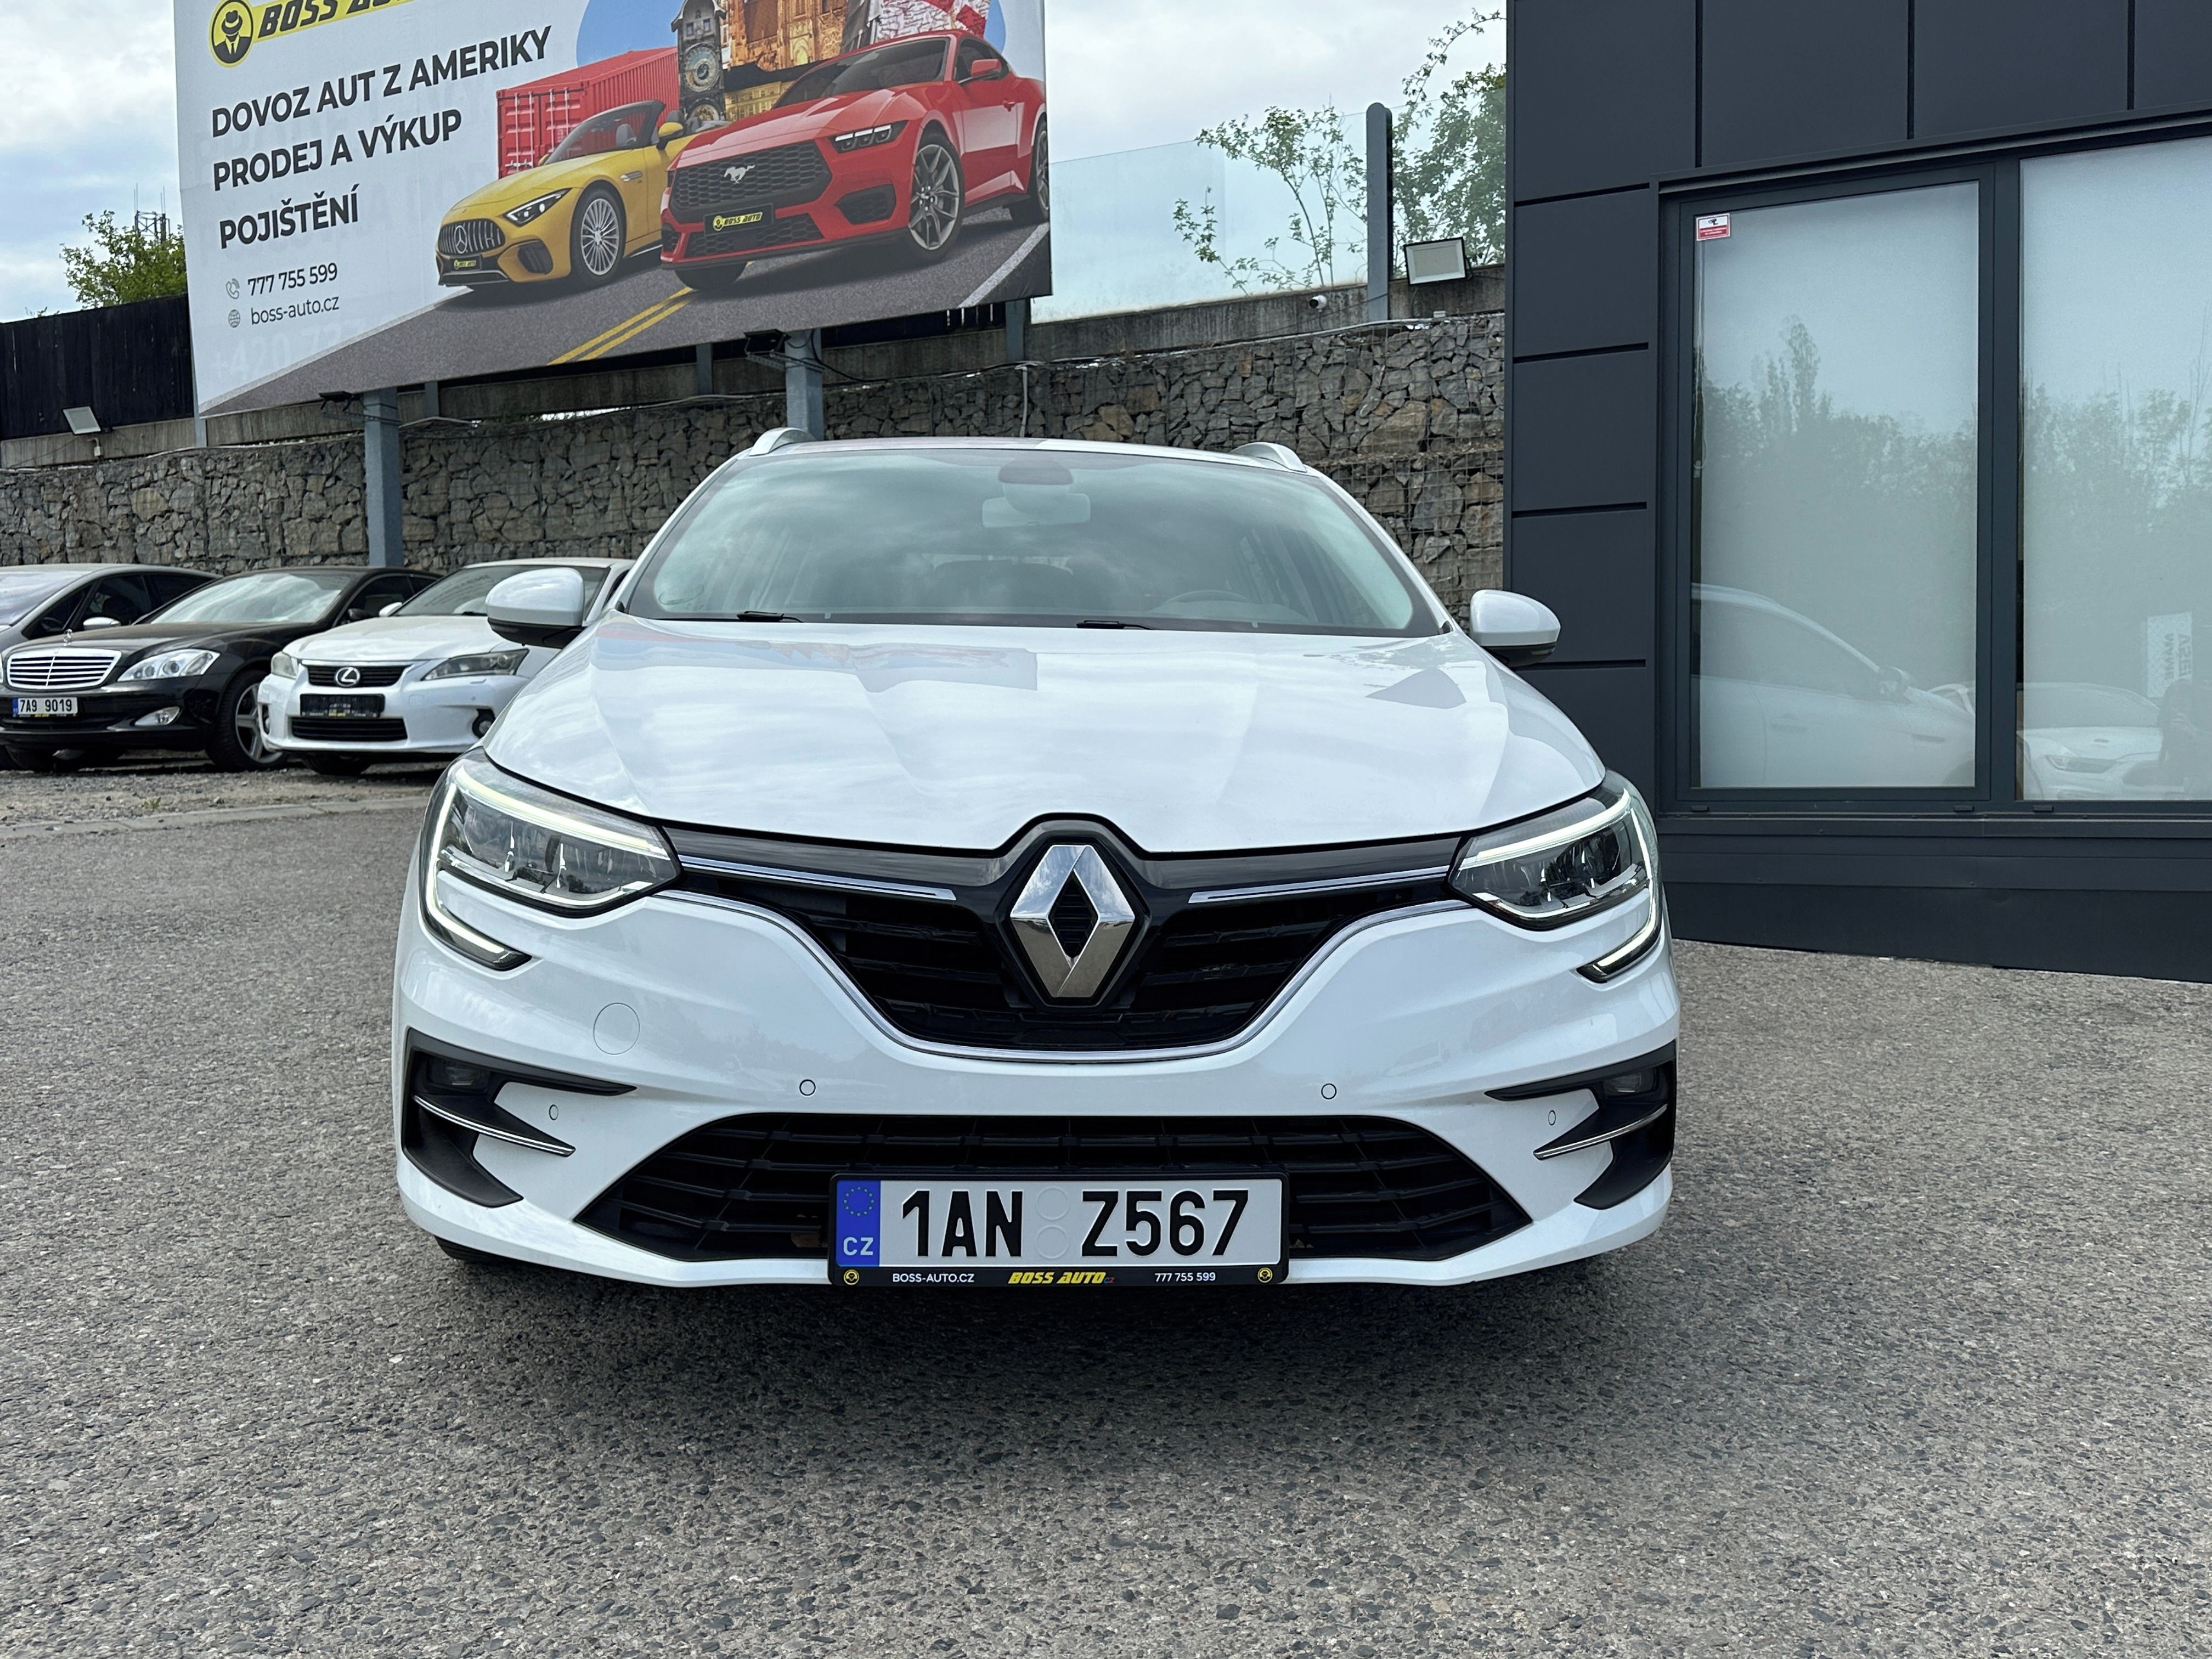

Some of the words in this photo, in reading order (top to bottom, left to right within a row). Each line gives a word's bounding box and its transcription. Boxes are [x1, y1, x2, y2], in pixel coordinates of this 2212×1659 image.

[258, 0, 338, 38] BOSS
[212, 86, 311, 138] DOVOZ
[317, 69, 376, 113] AUT
[383, 64, 403, 97] Z
[409, 25, 552, 92] AMERIKY
[215, 139, 323, 191] PRODEJ
[331, 134, 353, 166] A
[358, 109, 461, 158] VÝKUP
[219, 183, 360, 249] POJIŠTĚNÍ
[247, 274, 275, 296] 777
[278, 268, 306, 291] 755
[309, 262, 338, 285] 599
[251, 296, 340, 325] boss-auto.cz
[20, 699, 37, 712] 7A9
[45, 699, 72, 712] 9019
[901, 1190, 1024, 1257] 1AN
[1081, 1189, 1250, 1257] Z567
[843, 1237, 874, 1256] CZ
[892, 1273, 975, 1283] BOSS-AUTO.CZ
[1008, 1272, 1055, 1284] BOSS
[1056, 1272, 1107, 1284] AUTO
[1154, 1273, 1172, 1282] 777
[1175, 1272, 1194, 1282] 755
[1196, 1272, 1216, 1282] 599
